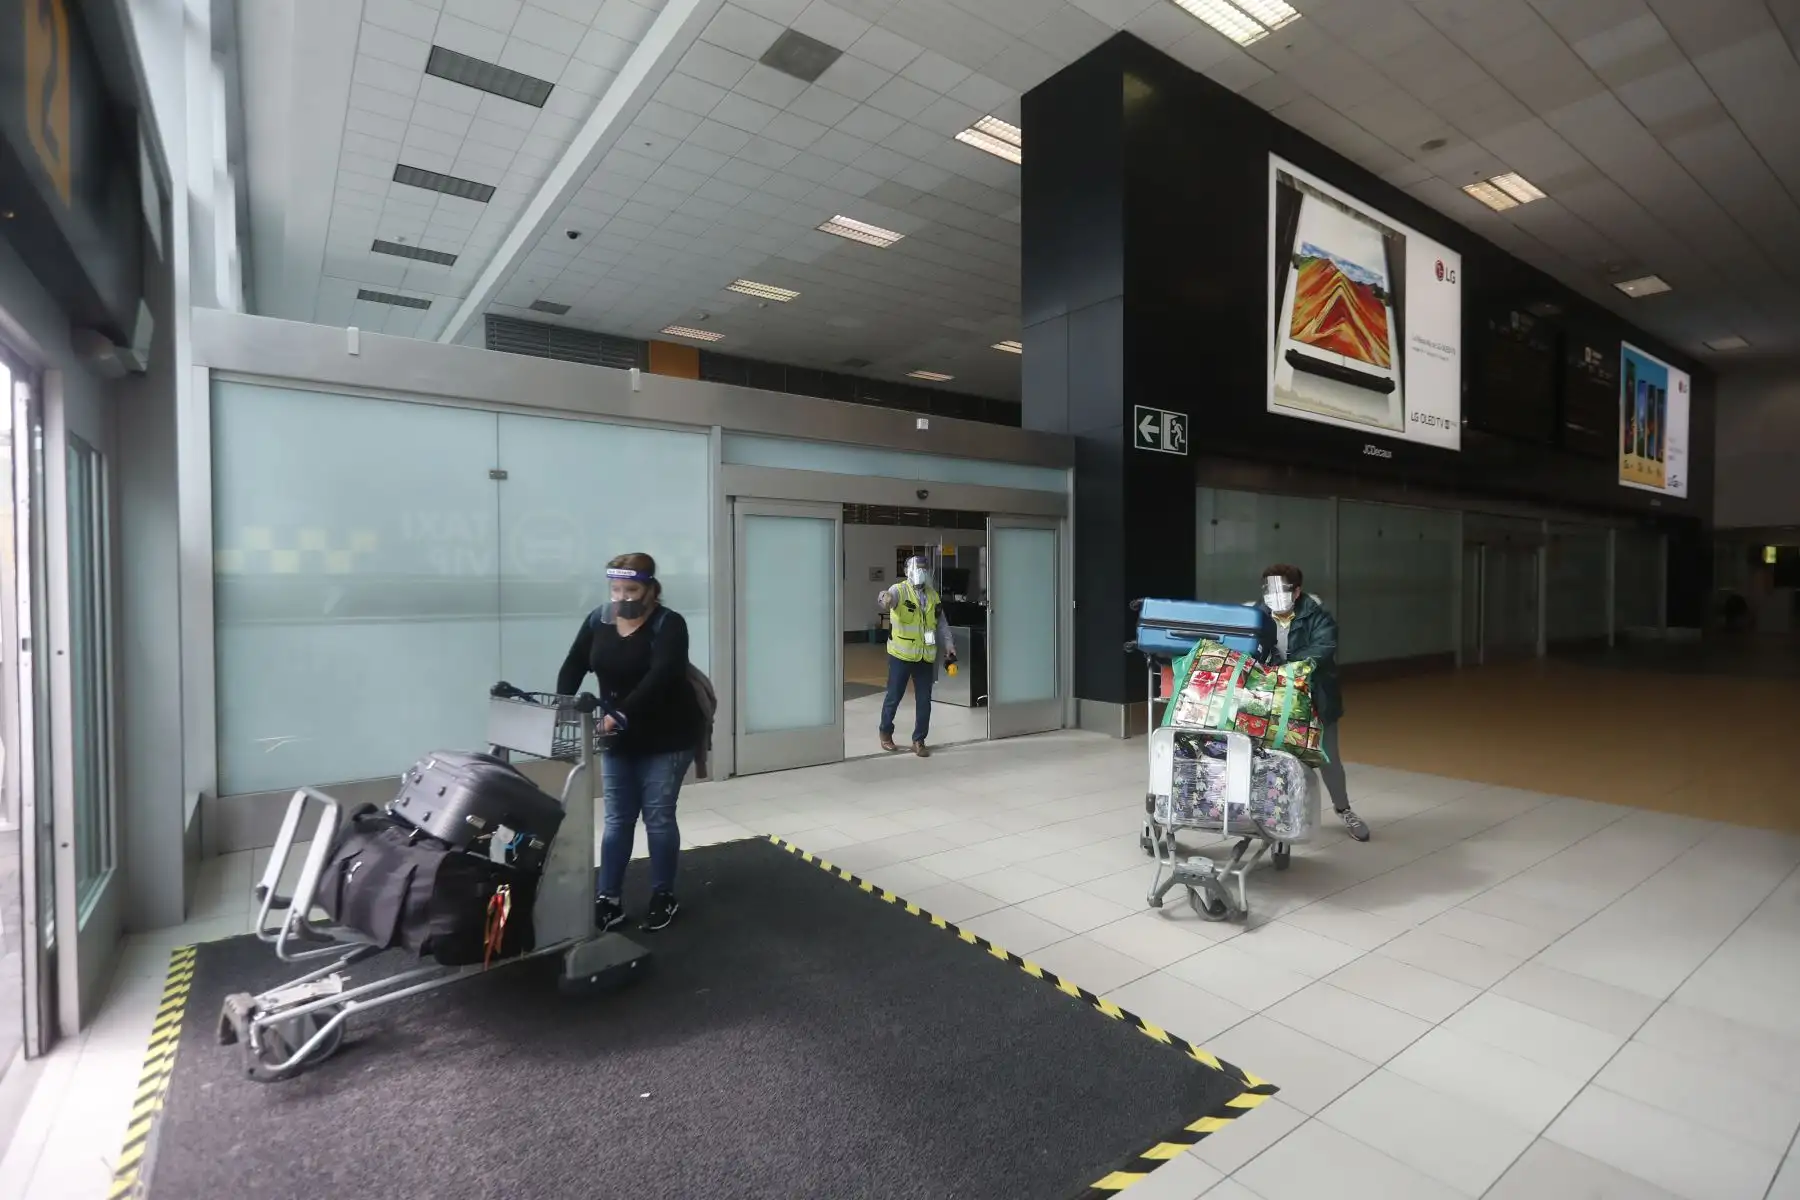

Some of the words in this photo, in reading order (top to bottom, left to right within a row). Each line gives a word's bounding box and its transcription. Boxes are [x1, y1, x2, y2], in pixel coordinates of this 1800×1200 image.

[1445, 266, 1456, 285] LG
[1410, 411, 1419, 423] LG
[1420, 413, 1435, 427] OLED
[1435, 417, 1444, 429] TV
[1363, 443, 1392, 459] JCDecaux
